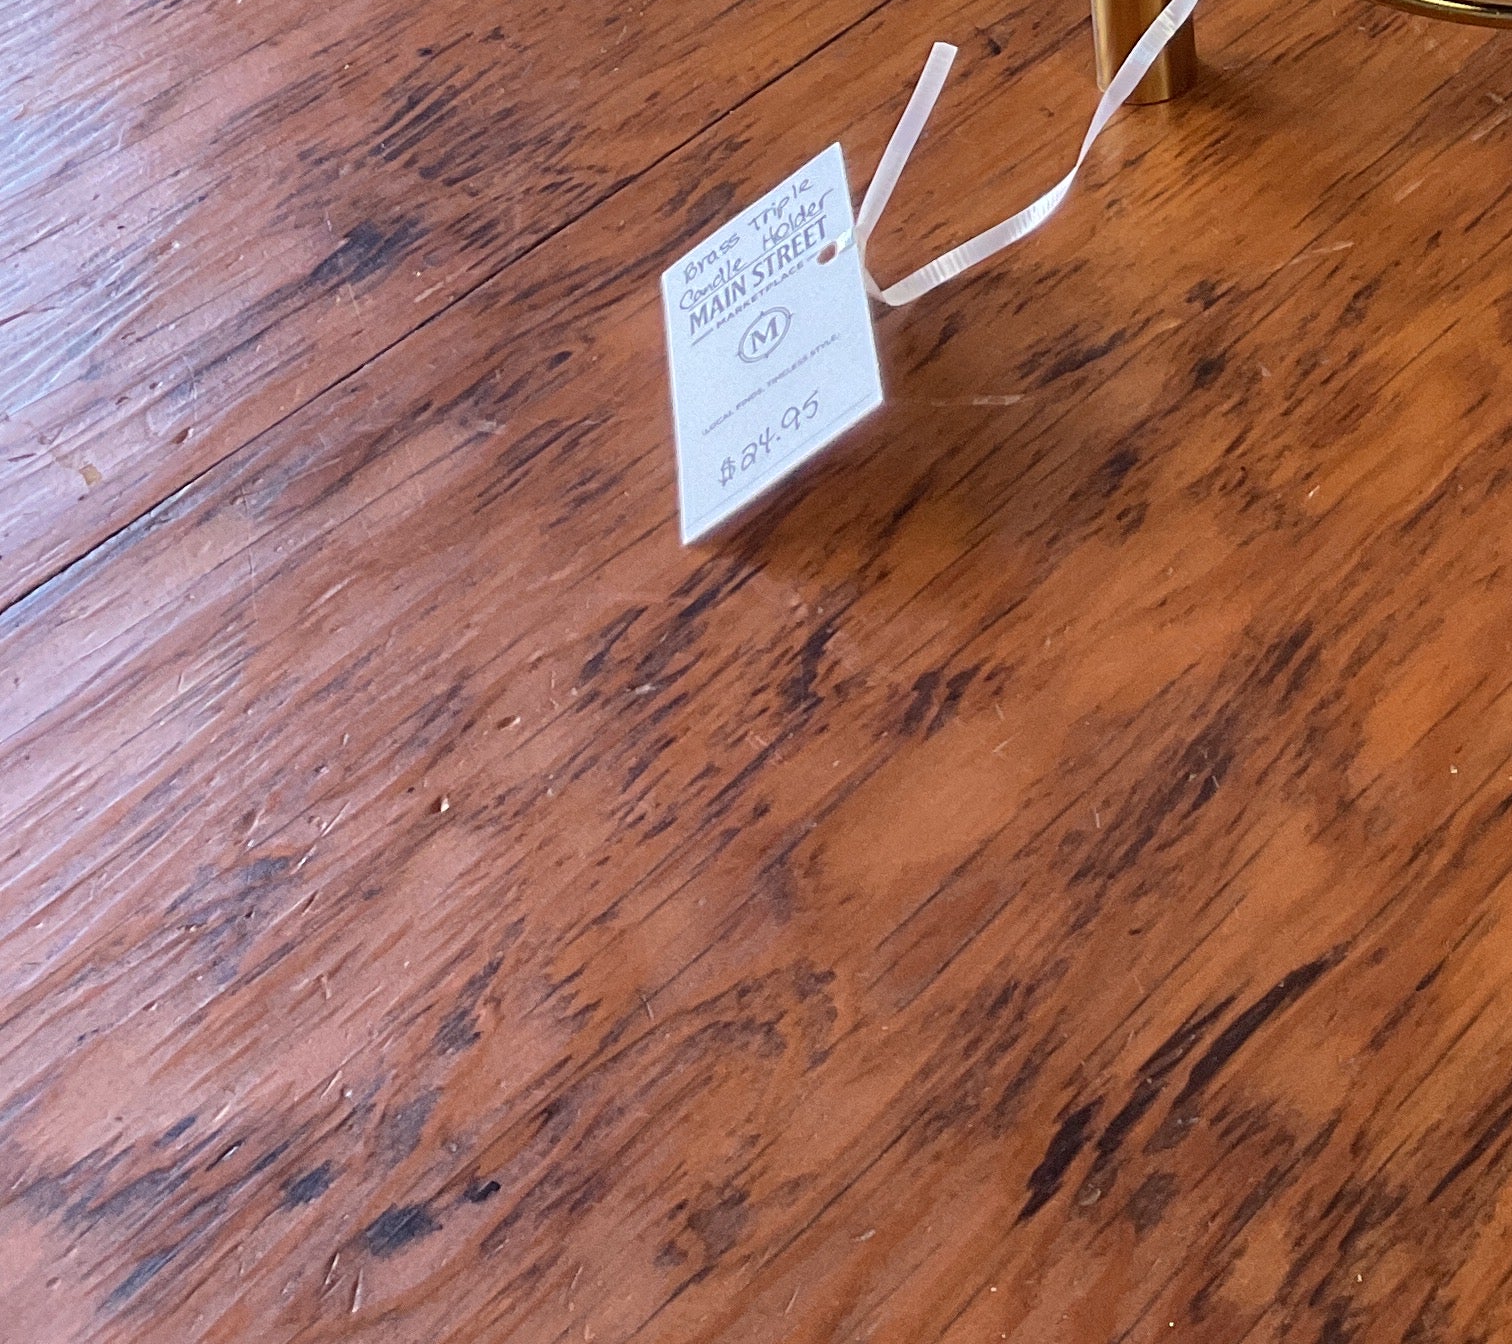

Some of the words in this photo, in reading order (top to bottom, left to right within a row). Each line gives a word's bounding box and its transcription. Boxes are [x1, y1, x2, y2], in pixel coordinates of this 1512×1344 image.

[679, 257, 746, 310] Candle
[763, 188, 834, 252] Holder
[684, 233, 740, 284] Brass
[748, 178, 813, 231] Triple
[689, 275, 746, 335] MAIN
[752, 215, 827, 287] STREET
[717, 261, 804, 329] MARKETPLACE
[750, 317, 779, 354] M
[702, 411, 734, 435] LOCAL
[767, 355, 807, 386] TIMELESS
[718, 389, 819, 487] $24.95
